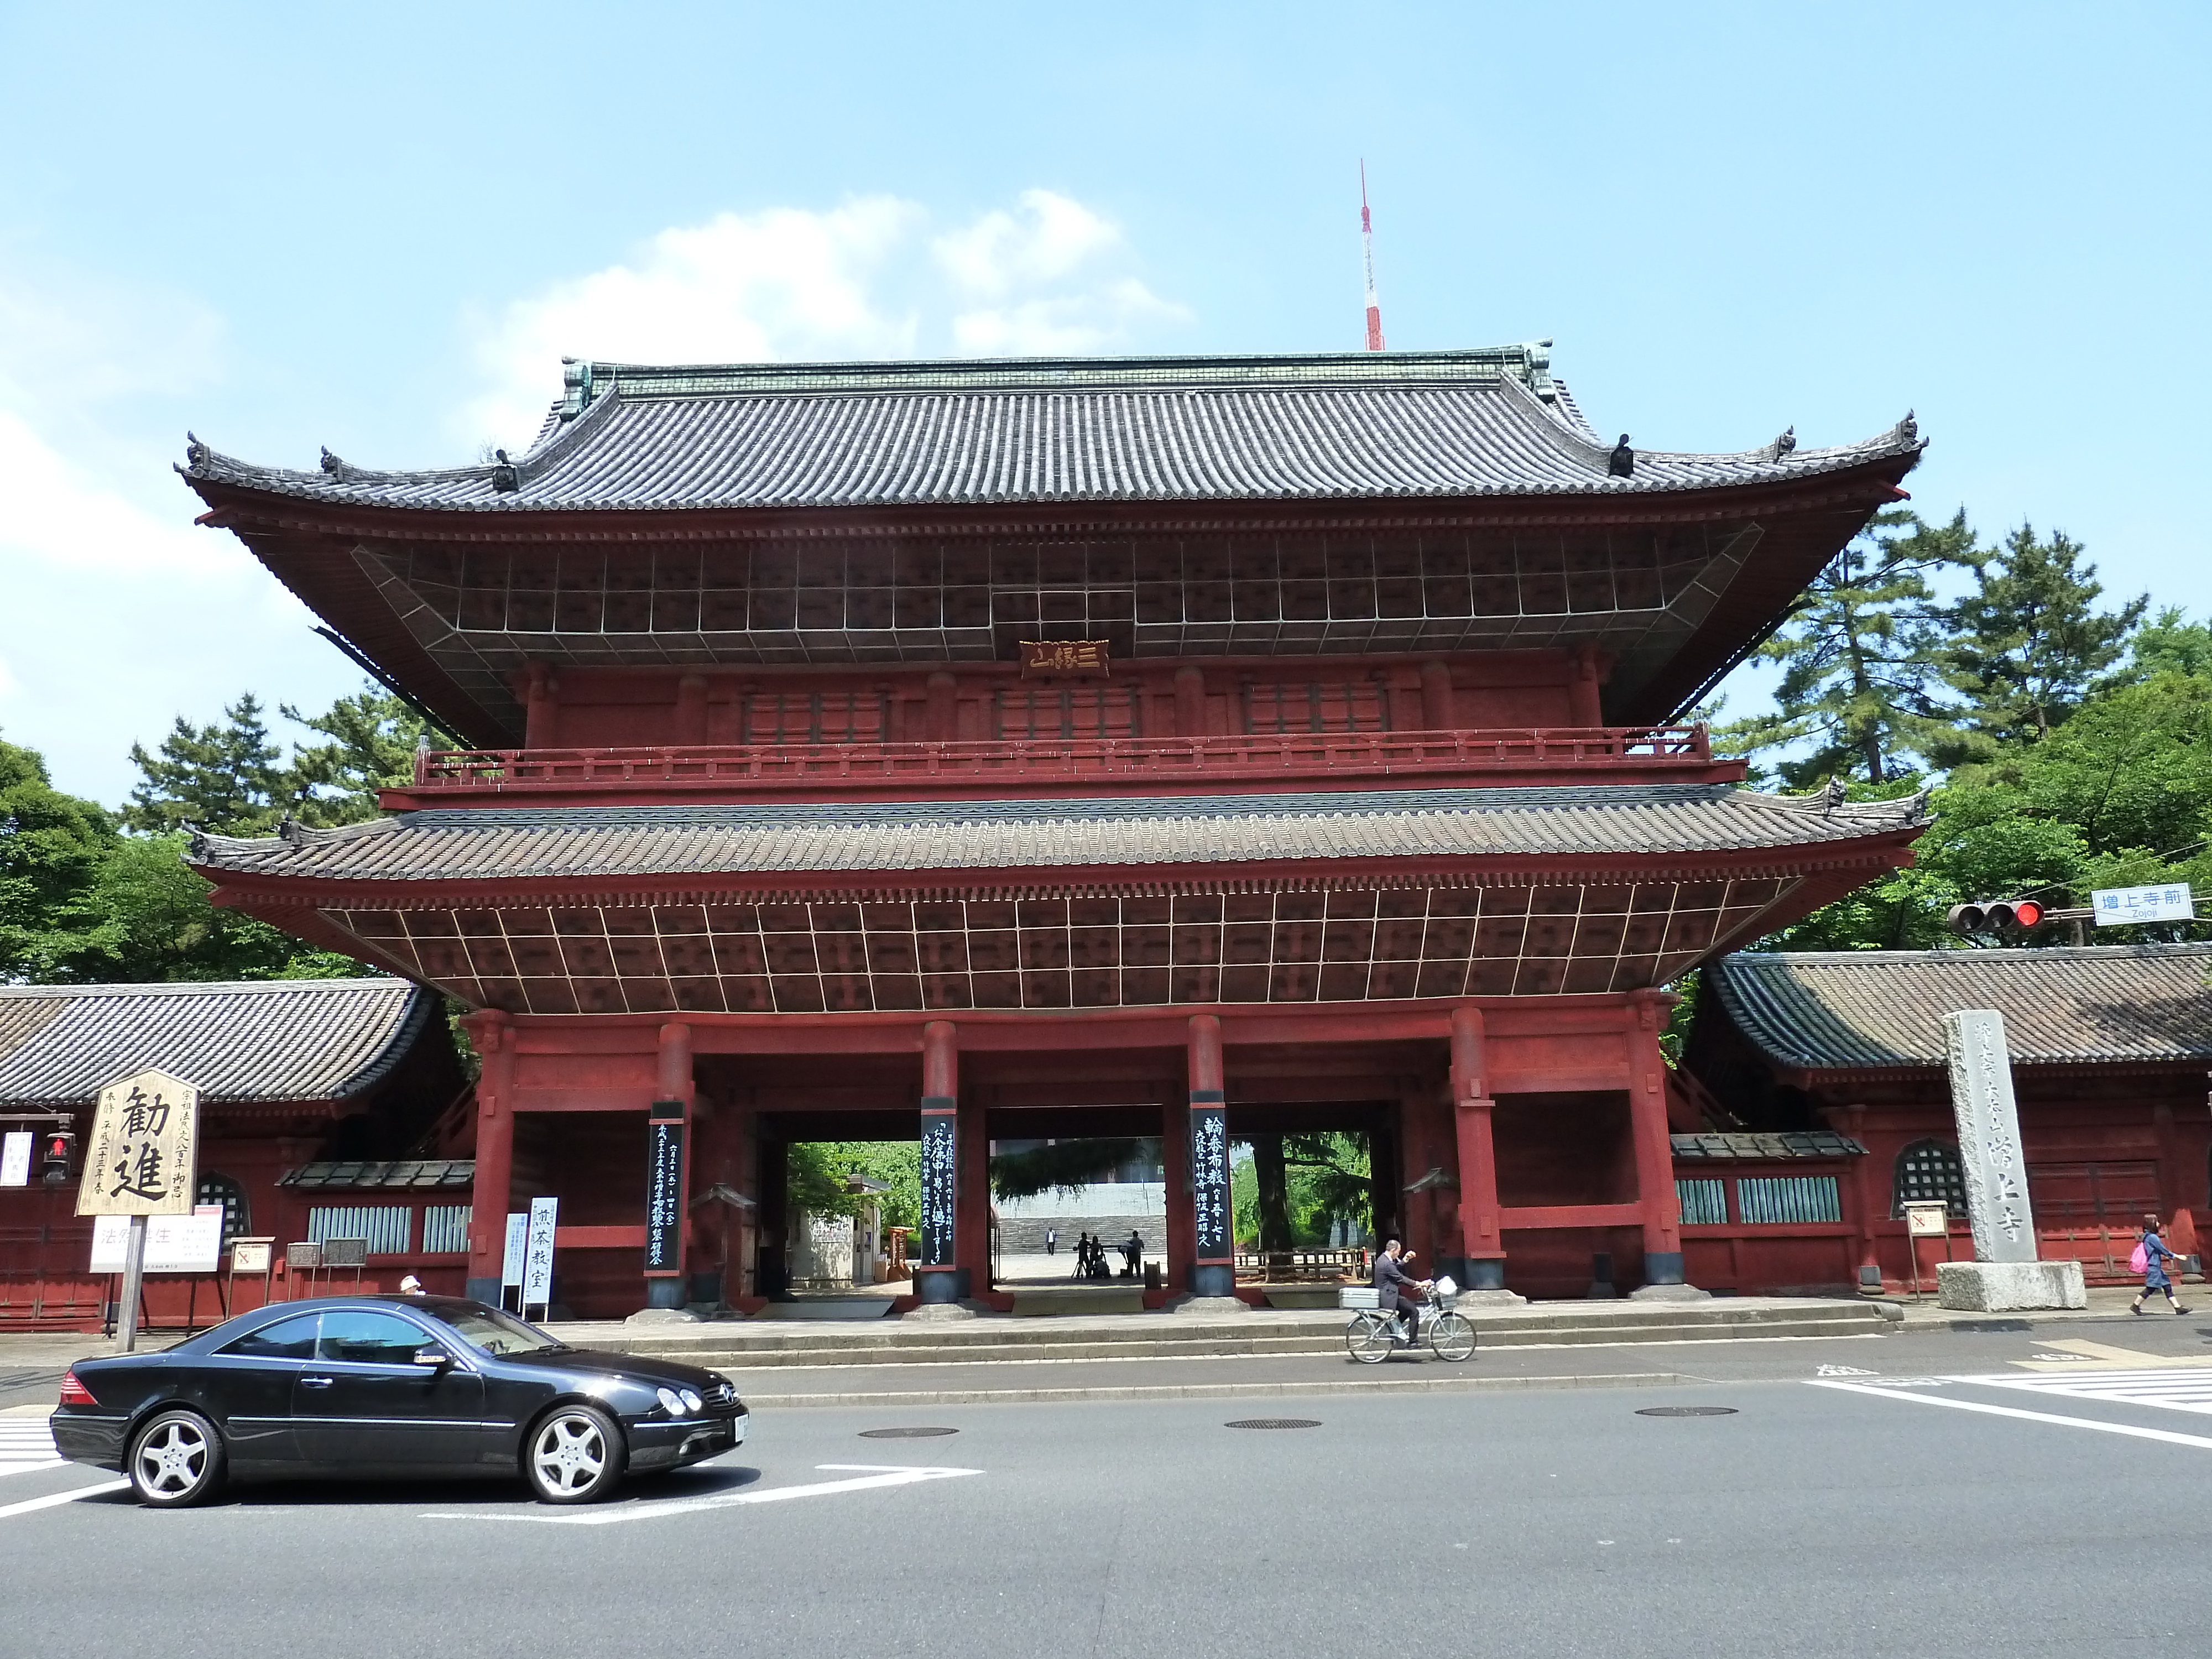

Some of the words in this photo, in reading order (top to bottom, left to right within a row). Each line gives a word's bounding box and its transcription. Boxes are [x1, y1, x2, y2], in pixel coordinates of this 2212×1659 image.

[2101, 889, 2181, 909] 増上寺前
[2131, 909, 2158, 919] Zojoji
[110, 1086, 171, 1201] 勧進
[1204, 1116, 1226, 1185] 輪番布教
[1196, 1161, 1208, 1190] 竹林寺
[531, 1208, 551, 1288] 煎茶教室
